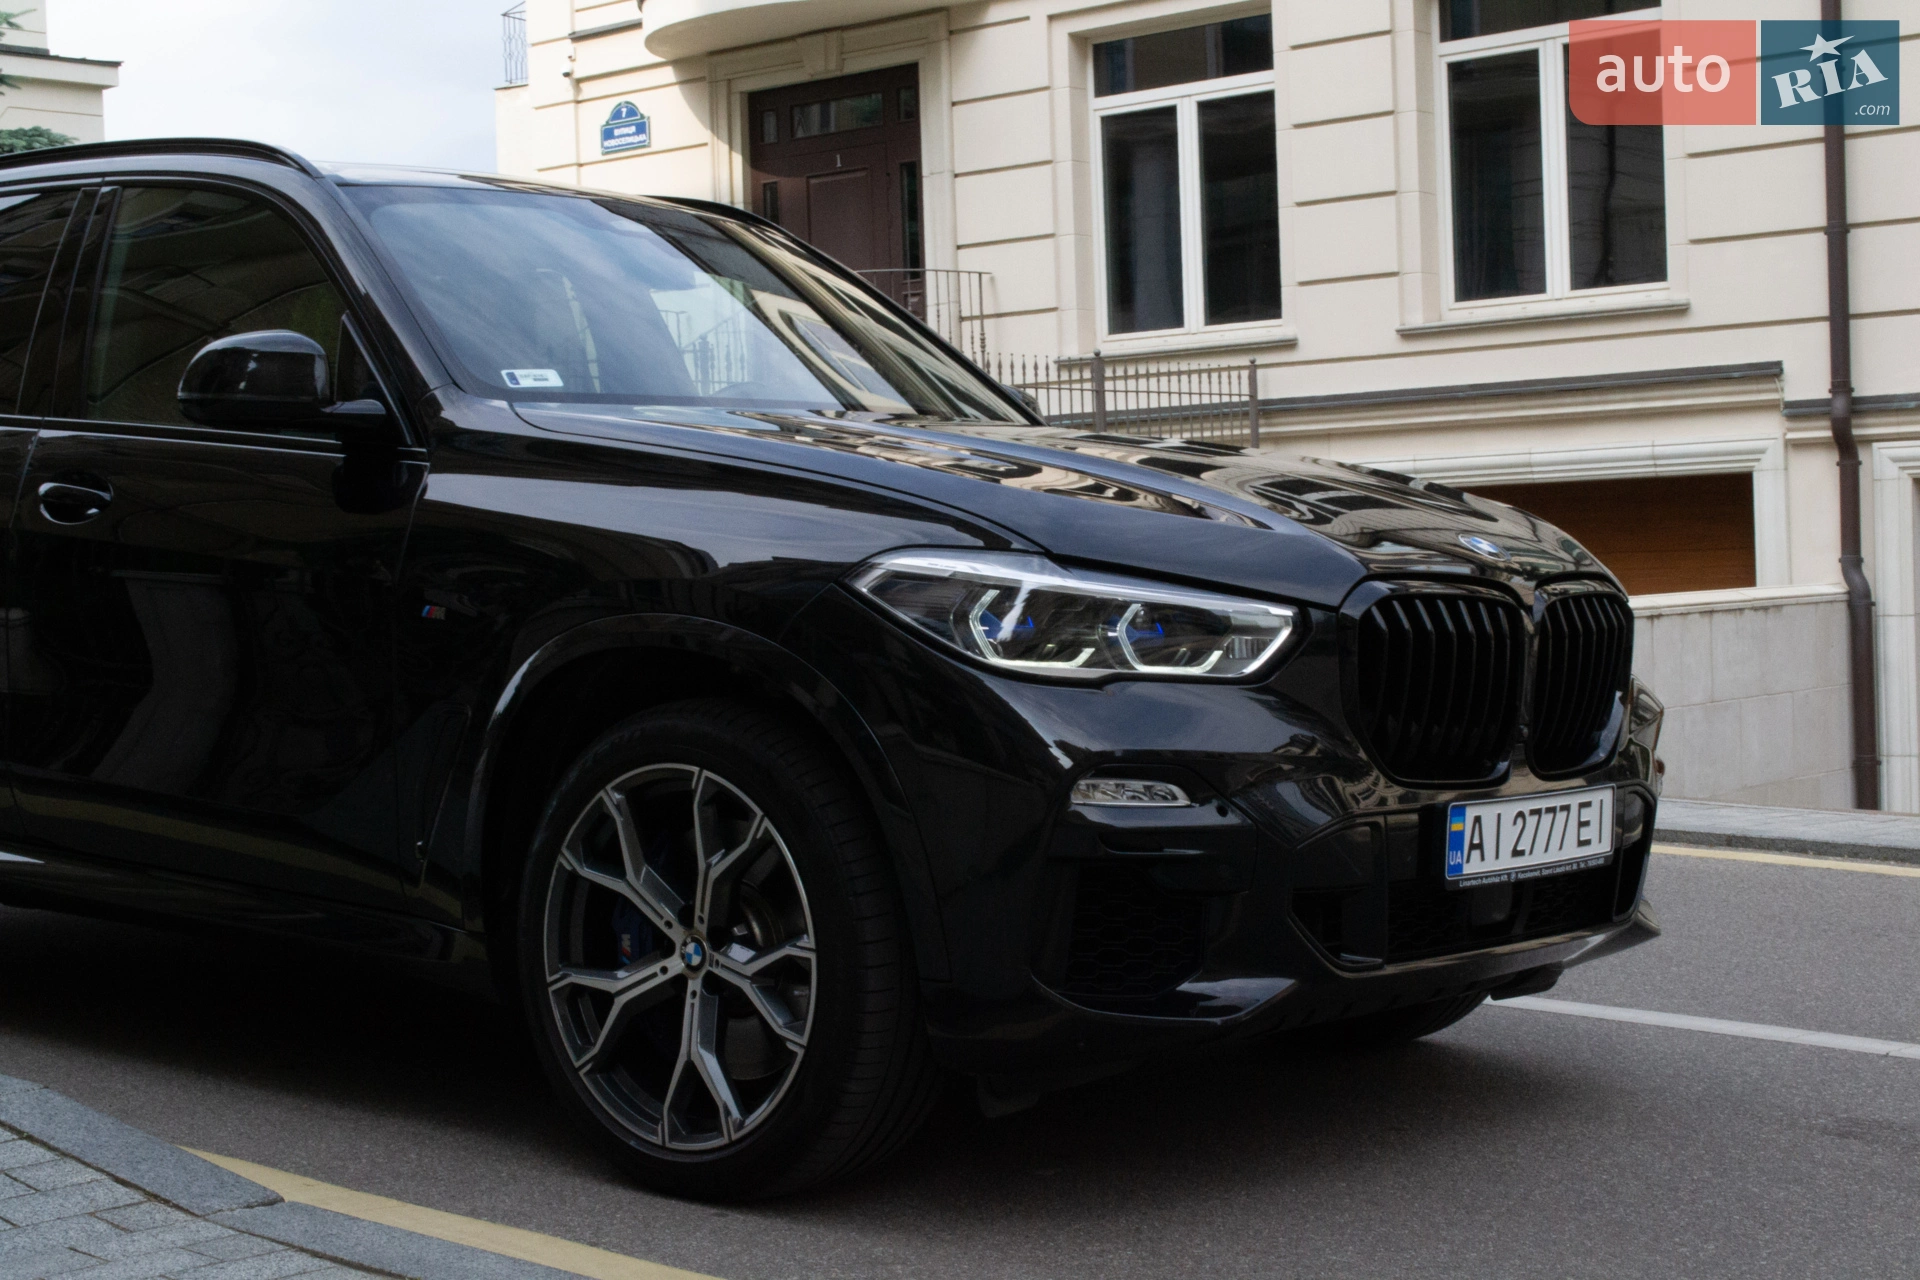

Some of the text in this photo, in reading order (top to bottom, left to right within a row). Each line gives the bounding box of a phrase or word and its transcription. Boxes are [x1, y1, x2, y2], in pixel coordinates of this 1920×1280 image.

[835, 153, 842, 168] 1
[1465, 798, 1604, 864] AI 2777 EI
[1449, 850, 1463, 866] UA
